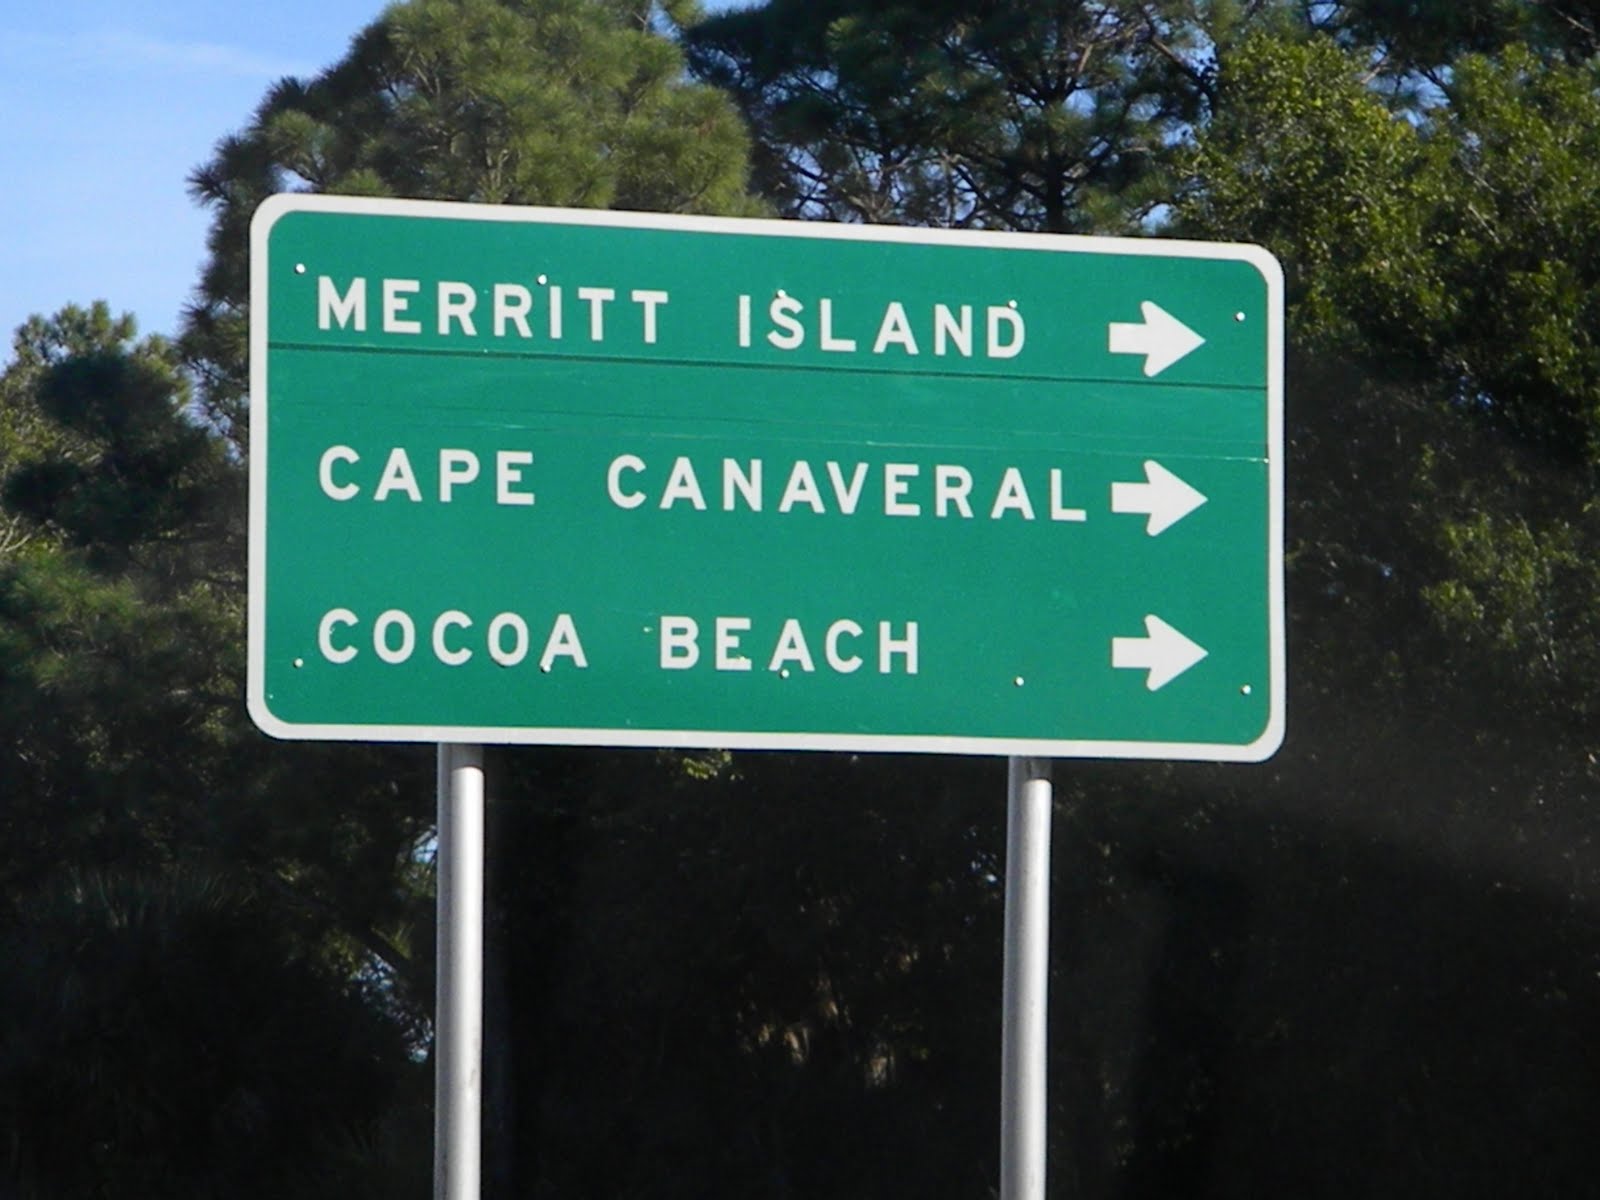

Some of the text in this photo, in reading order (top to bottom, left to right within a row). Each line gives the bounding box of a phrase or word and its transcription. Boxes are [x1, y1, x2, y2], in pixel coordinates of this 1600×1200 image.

[317, 275, 1026, 359] MERRITT ISLAND
[318, 445, 1088, 522] CAPE CANAVERAL
[317, 608, 919, 675] COCOA BEACH
